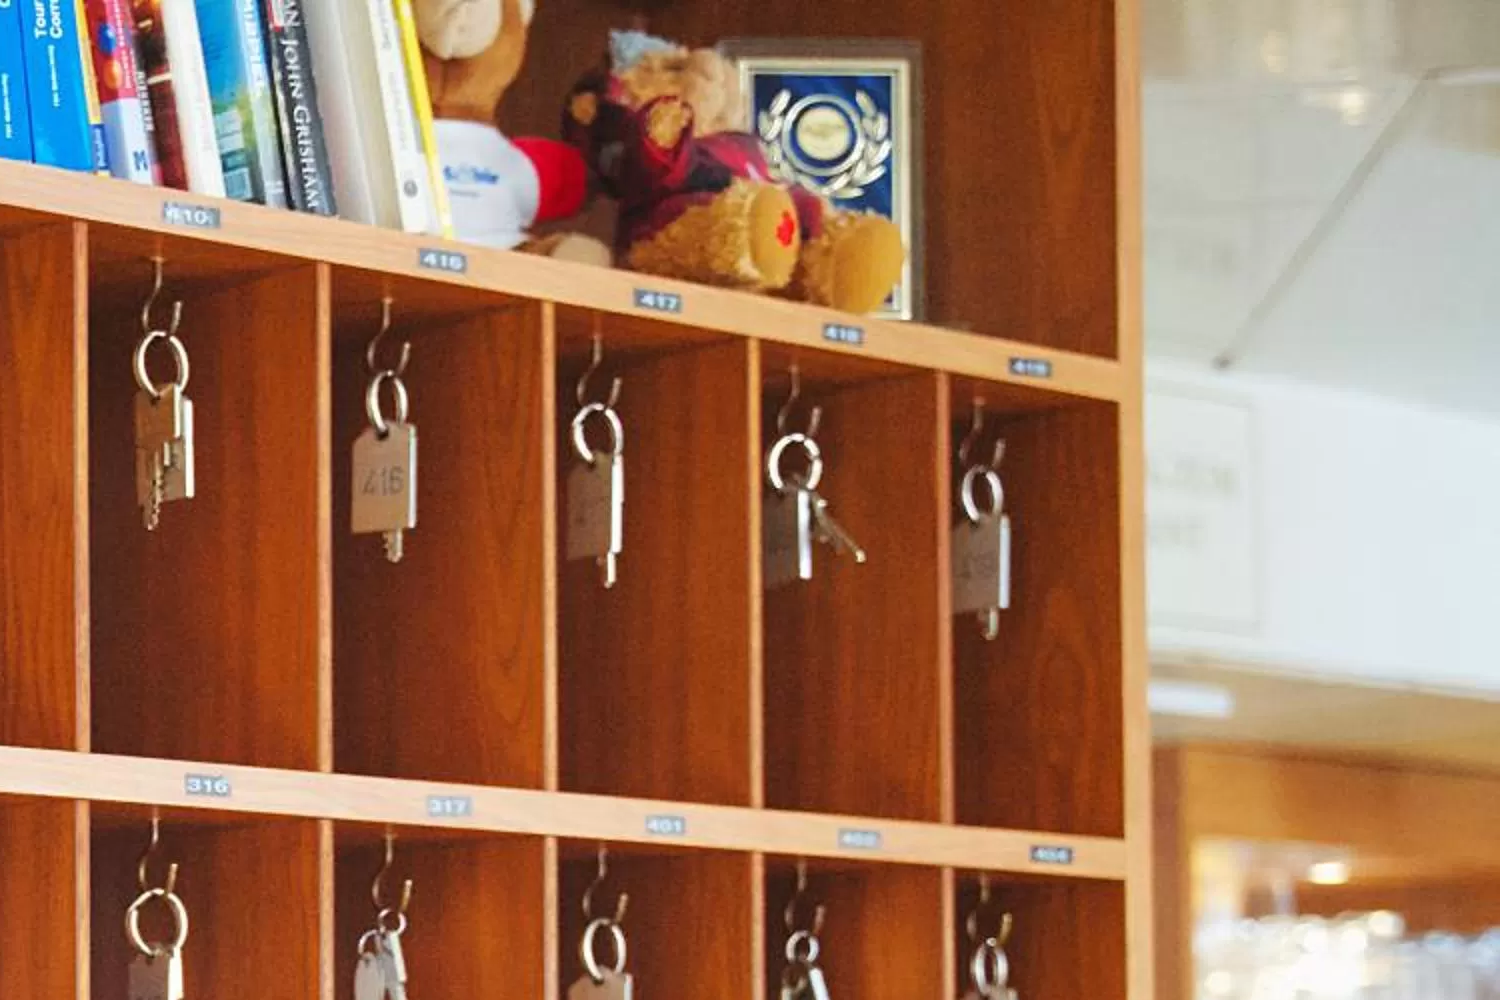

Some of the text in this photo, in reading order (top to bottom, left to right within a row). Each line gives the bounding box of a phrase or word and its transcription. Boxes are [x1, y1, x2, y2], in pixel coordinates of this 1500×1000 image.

[280, 37, 320, 208] JOHN GRISHAM
[186, 778, 229, 794] 316
